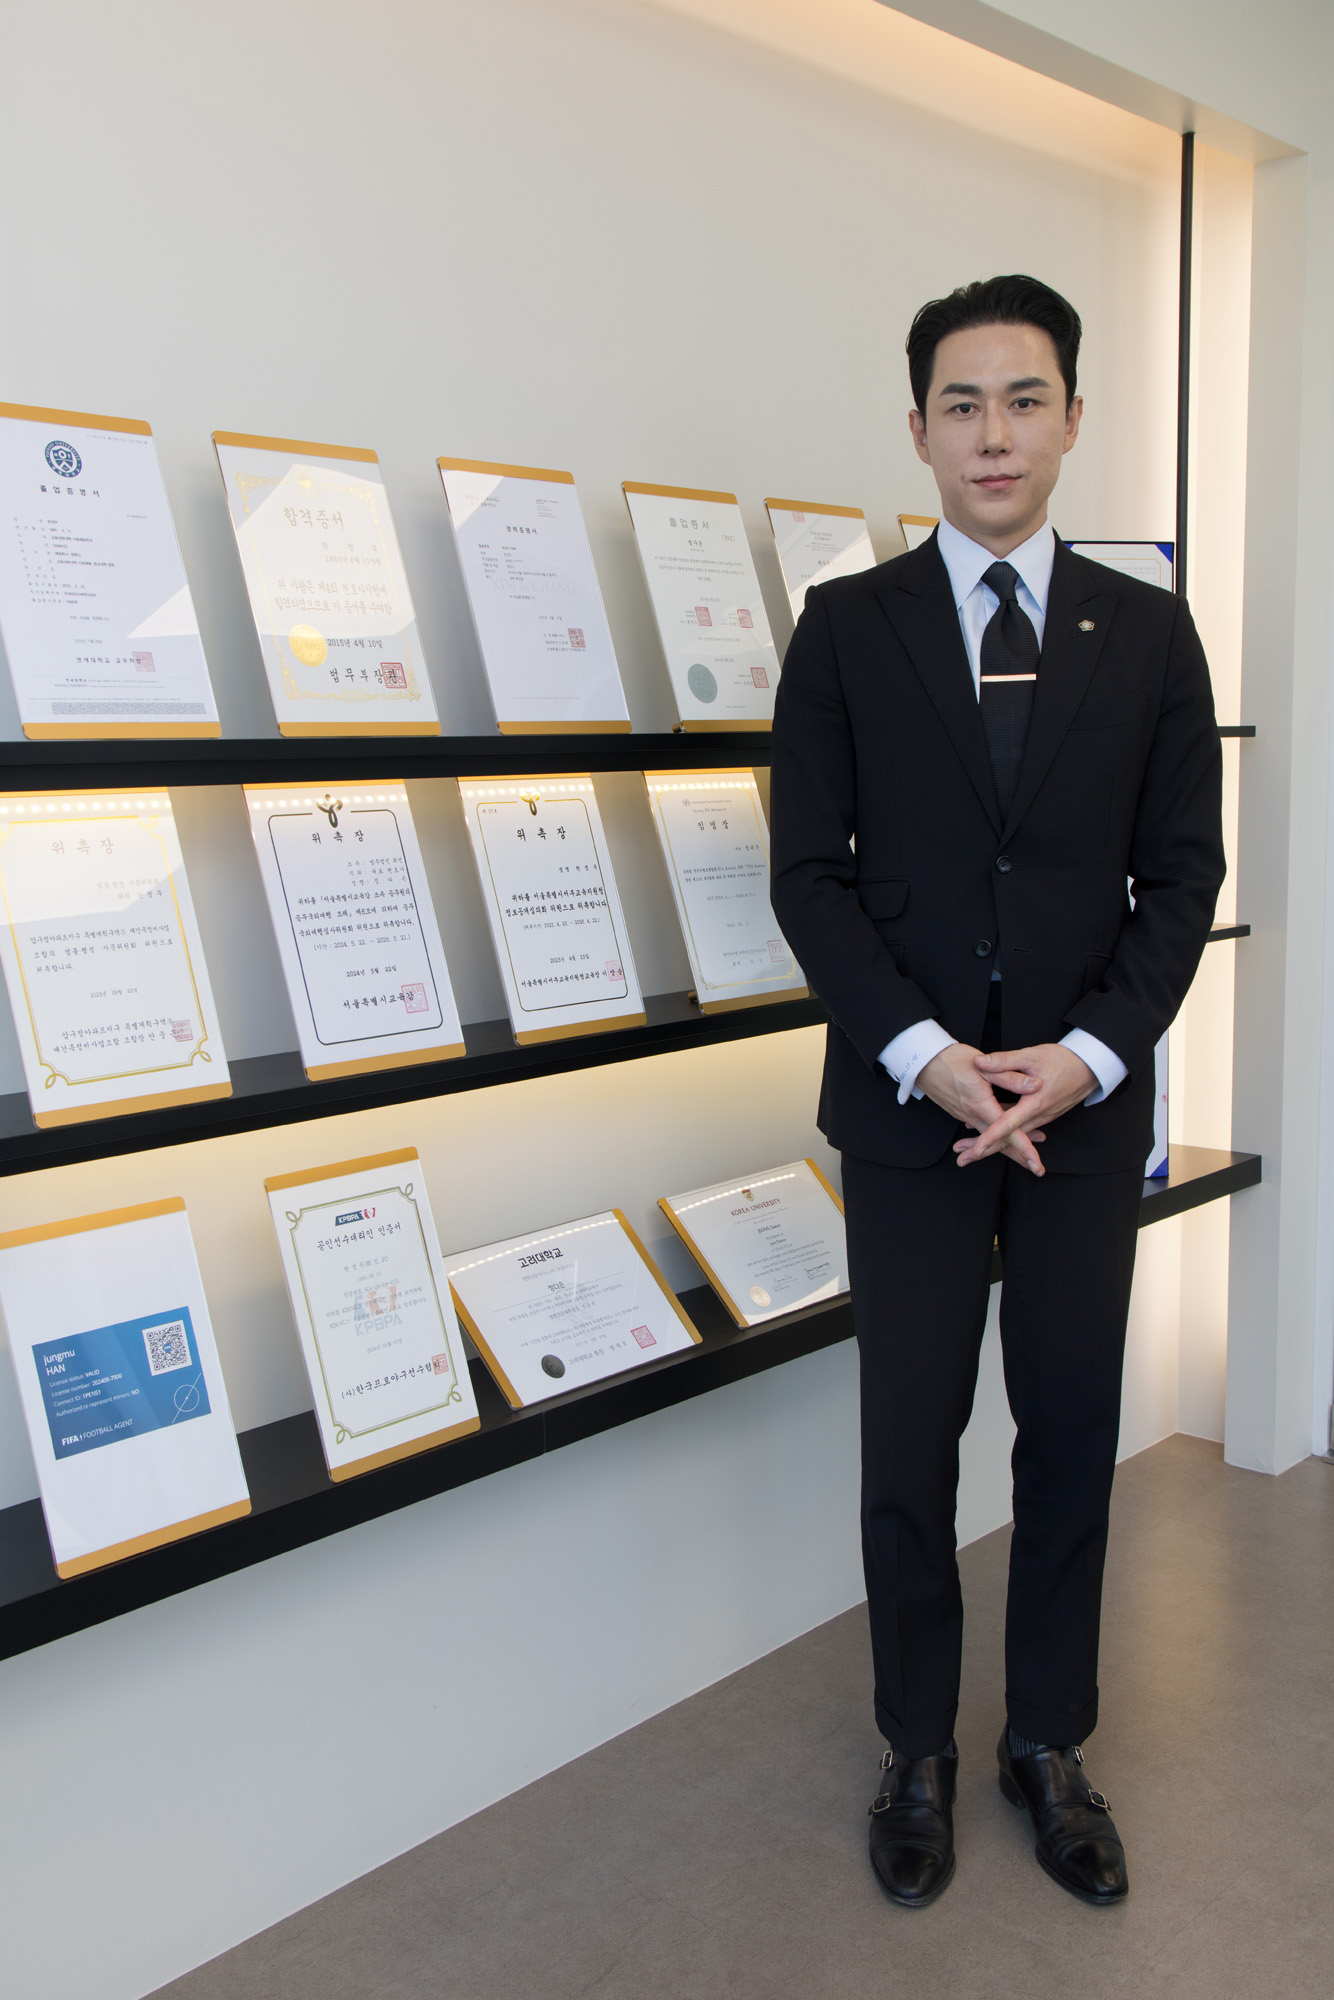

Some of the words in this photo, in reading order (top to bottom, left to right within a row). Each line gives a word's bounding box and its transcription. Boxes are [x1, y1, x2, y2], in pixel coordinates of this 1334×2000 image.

[283, 506, 344, 531] 합격증서
[327, 638, 351, 648] 2015년
[354, 639, 364, 649] 4월
[368, 639, 384, 649] 10일
[730, 1206, 751, 1217] KOREA
[749, 1197, 781, 1212] UNIVERSITY
[317, 1228, 375, 1252] 공인선수대리인
[377, 1221, 402, 1237] 인증서
[517, 1247, 564, 1269] 고려대학교
[547, 1281, 566, 1293] 정다은
[43, 1349, 76, 1366] jungmu
[46, 1363, 66, 1376] HAN
[131, 1388, 140, 1397] NO
[62, 1434, 80, 1446] FIFA
[83, 1424, 114, 1439] FOOTBALL
[113, 1418, 134, 1430] AGENT
